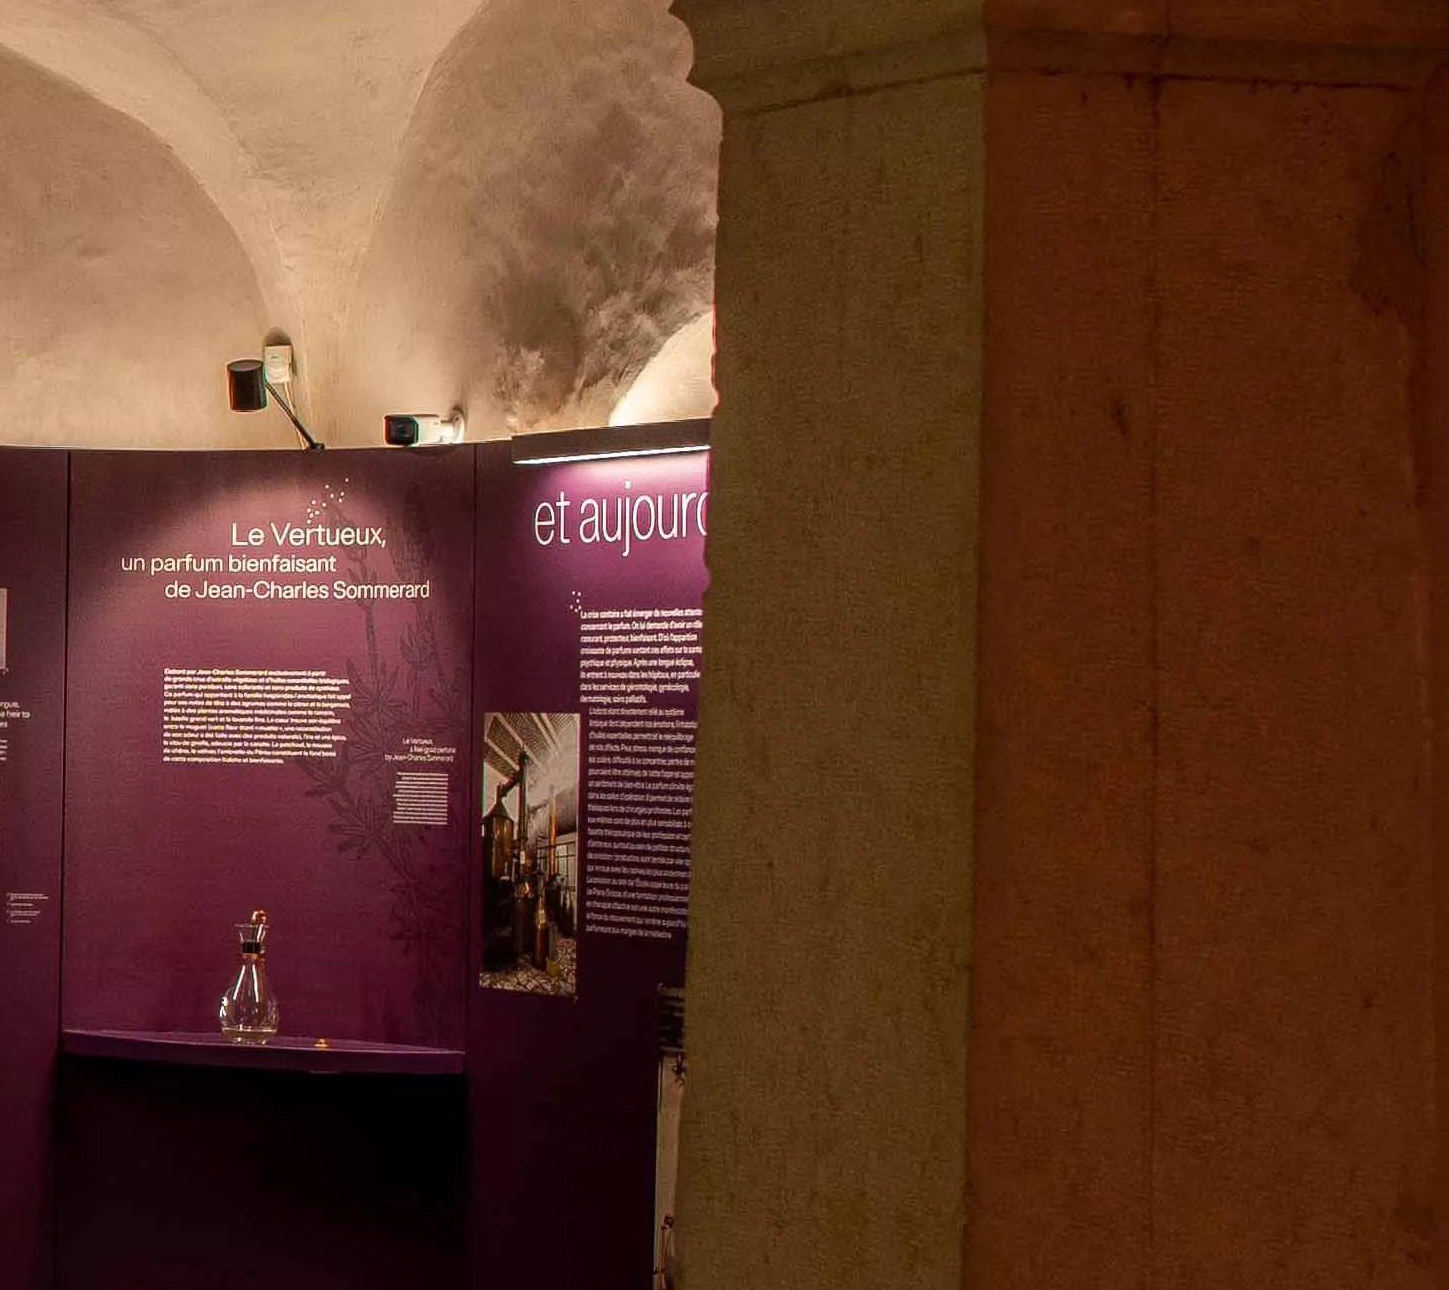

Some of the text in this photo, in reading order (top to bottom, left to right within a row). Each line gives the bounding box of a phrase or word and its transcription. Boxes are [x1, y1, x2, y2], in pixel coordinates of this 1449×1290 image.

[534, 490, 571, 546] et
[230, 522, 386, 549] Le Vertueux,
[120, 553, 337, 576] un parfum bienfaisant
[164, 579, 430, 600] de Jean-Charles Sommerard
